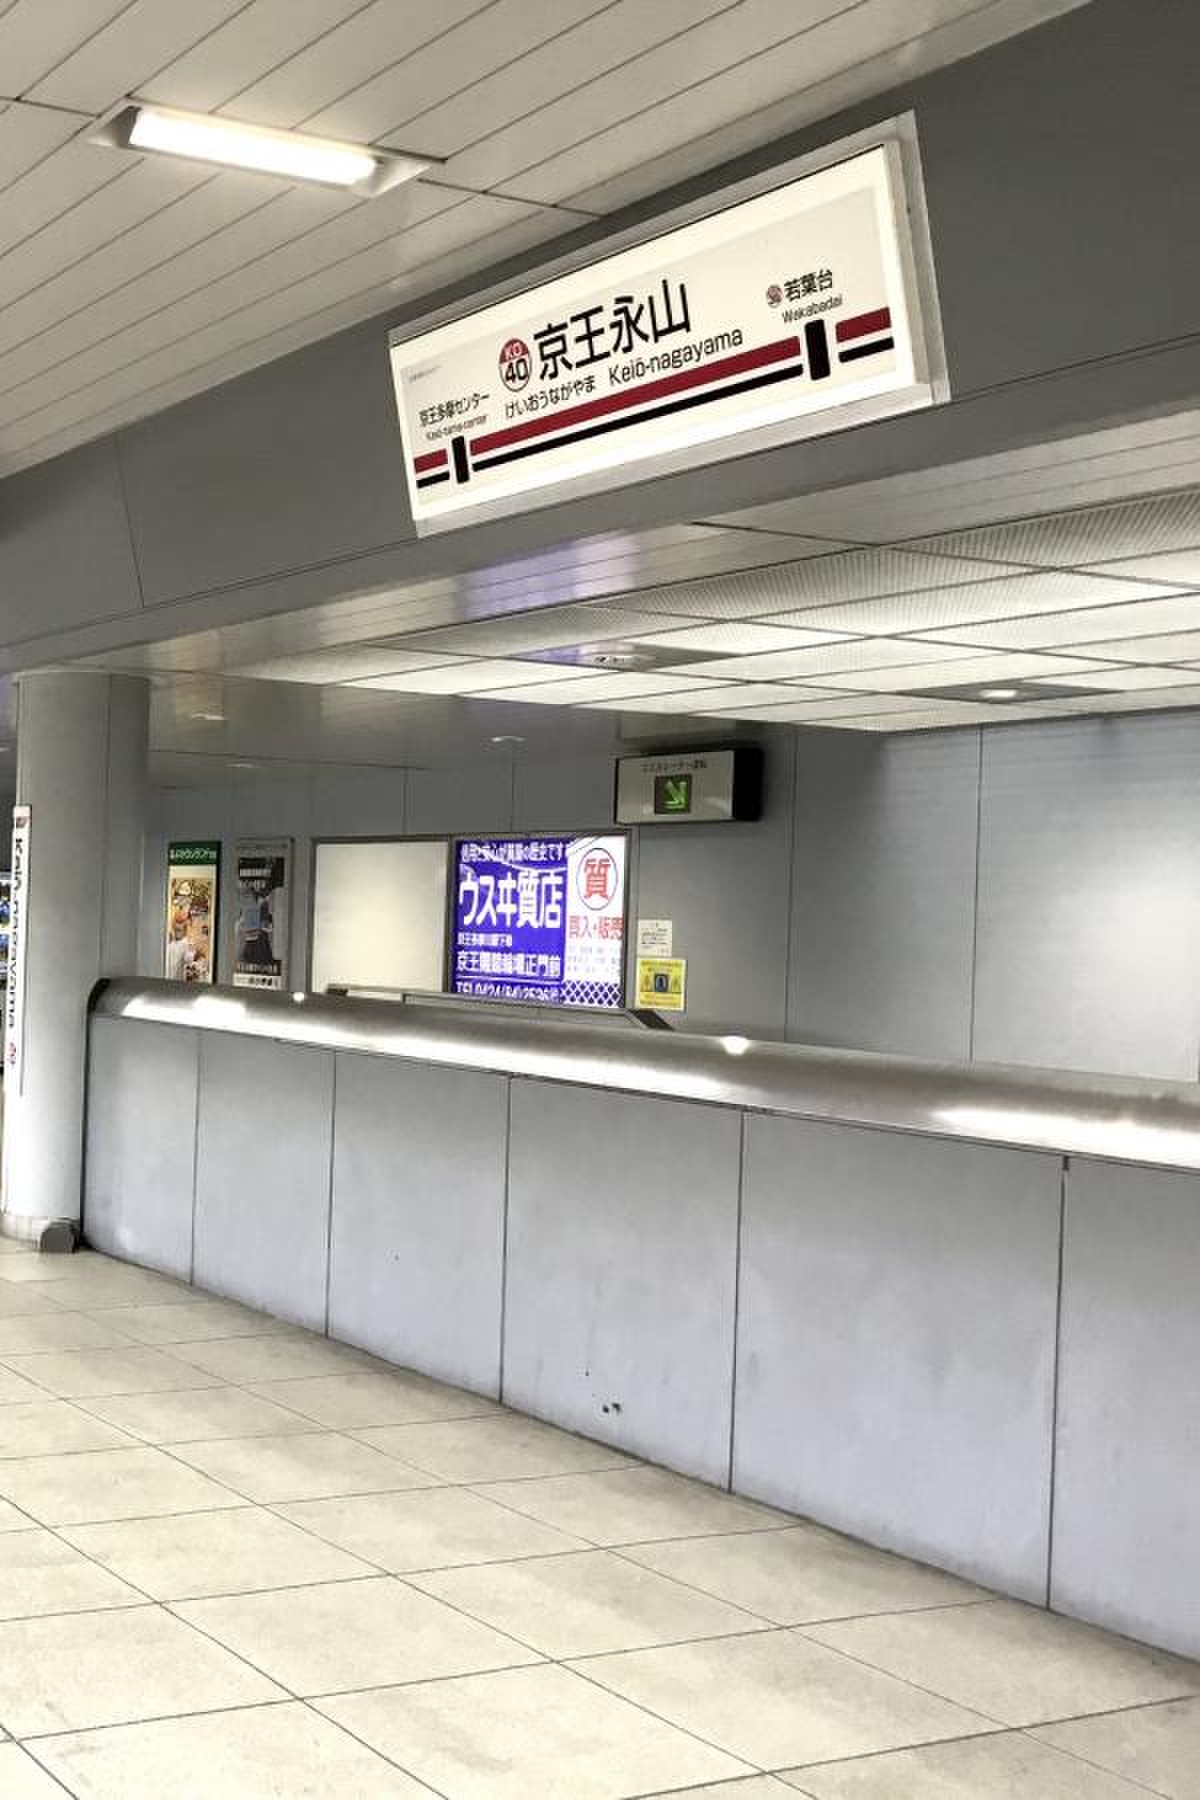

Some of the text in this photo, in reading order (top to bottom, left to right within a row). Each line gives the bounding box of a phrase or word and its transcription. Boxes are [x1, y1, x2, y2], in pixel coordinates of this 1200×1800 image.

[783, 269, 833, 302] 若葉台
[533, 279, 691, 380] 京王永山
[504, 358, 528, 384] 40
[505, 375, 596, 418] けいおうながやま
[458, 870, 564, 929] ウスヰ質店
[582, 858, 612, 901] 質
